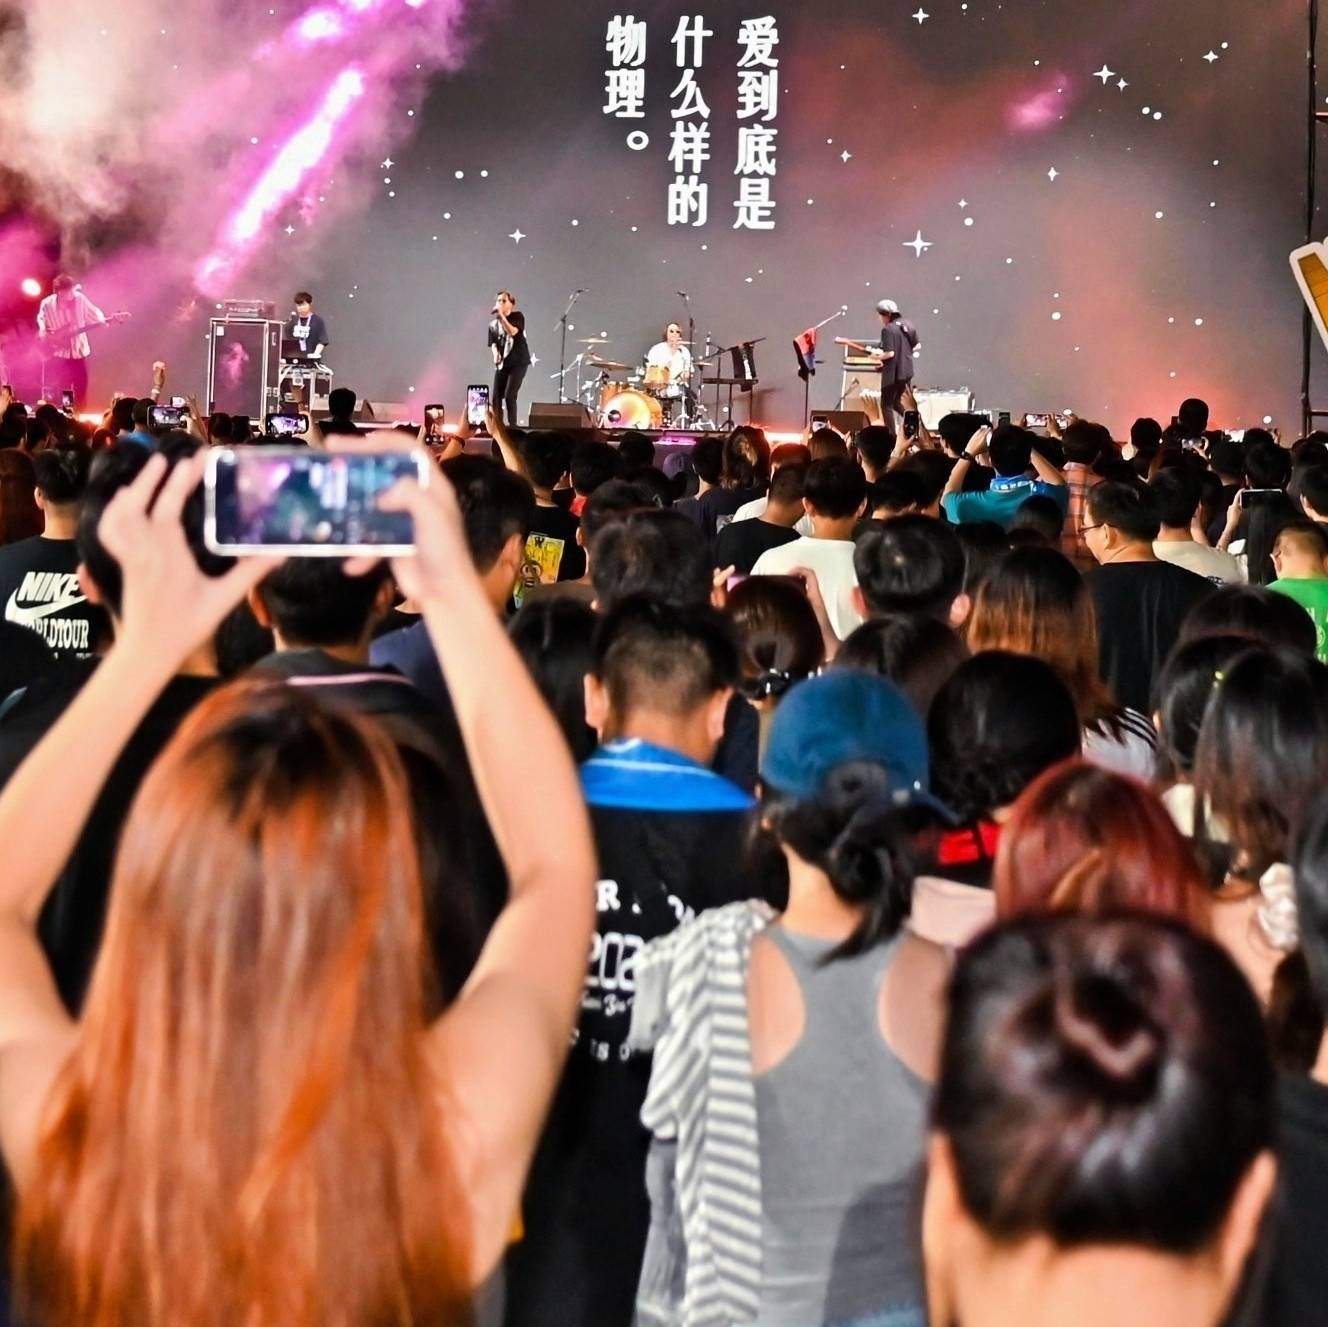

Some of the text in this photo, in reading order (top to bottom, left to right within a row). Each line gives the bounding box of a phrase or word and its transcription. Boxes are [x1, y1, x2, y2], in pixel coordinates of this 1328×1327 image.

[602, 15, 649, 151] 物理。
[667, 15, 713, 226] 什么样的
[733, 15, 779, 230] 爱到底是
[16, 571, 80, 602] NIKE
